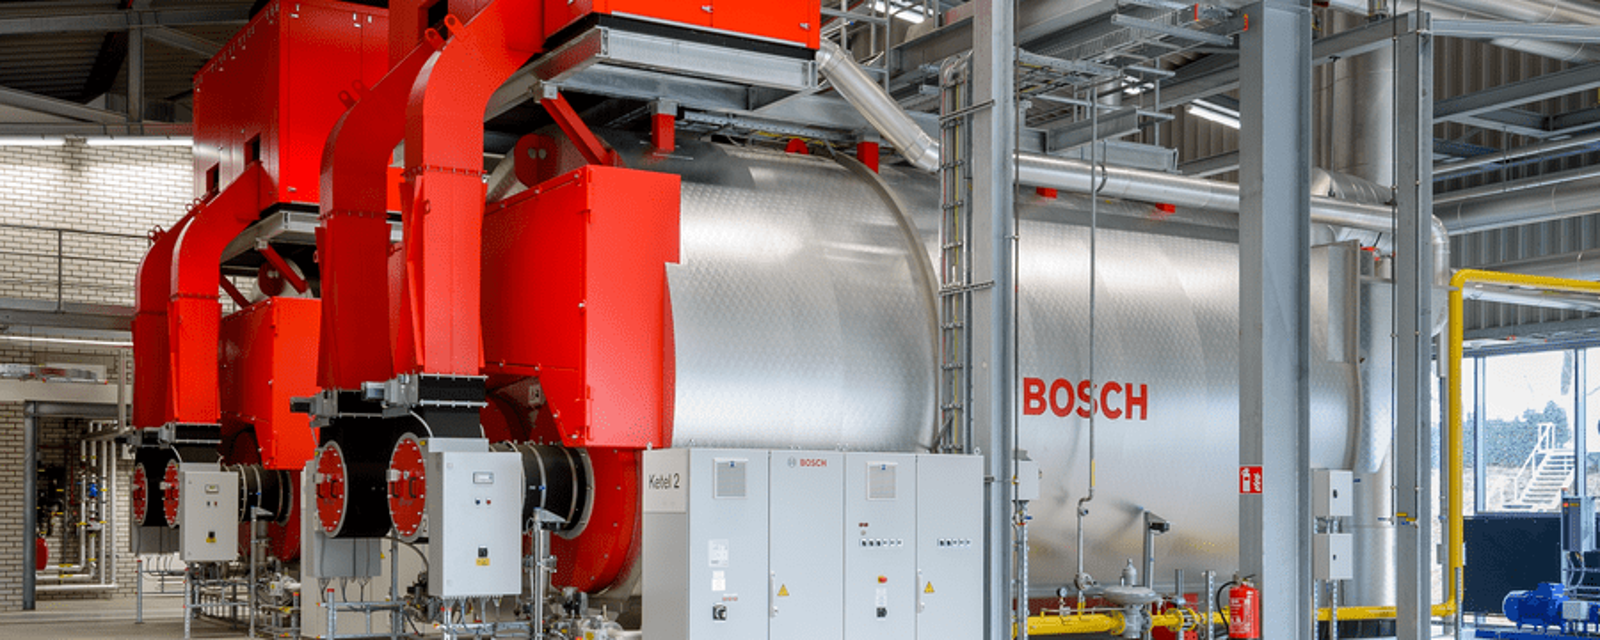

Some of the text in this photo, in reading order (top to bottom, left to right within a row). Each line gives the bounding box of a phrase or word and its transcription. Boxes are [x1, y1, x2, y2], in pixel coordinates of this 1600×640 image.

[1023, 377, 1147, 420] BOSCH
[800, 458, 827, 467] BOSCH
[649, 472, 680, 489] Ketel 2
